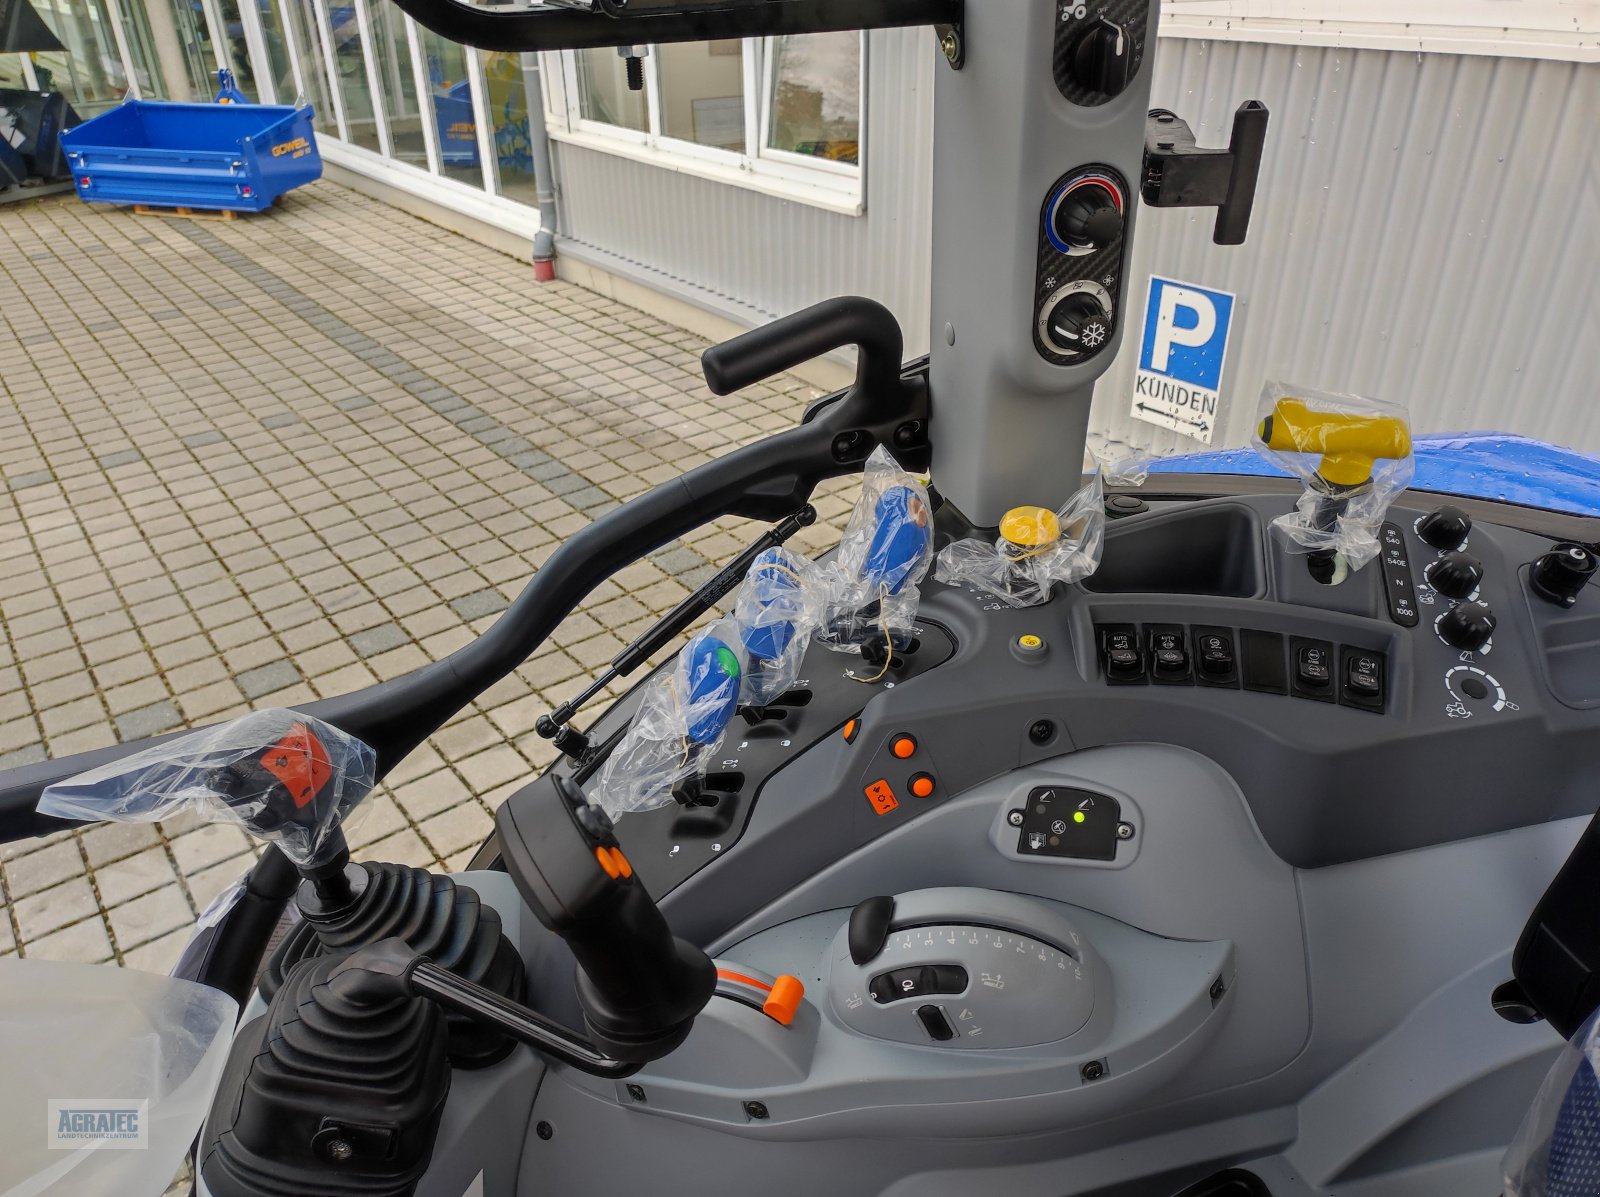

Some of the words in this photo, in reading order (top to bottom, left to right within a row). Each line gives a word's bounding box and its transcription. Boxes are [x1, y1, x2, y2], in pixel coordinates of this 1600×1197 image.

[1150, 283, 1218, 372] P
[1135, 375, 1217, 416] KUNDEN
[1385, 537, 1400, 545] 540
[1387, 557, 1407, 567] 540E
[1396, 607, 1413, 616] 1000
[993, 941, 1003, 949] 6
[1016, 946, 1026, 954] 7
[901, 979, 915, 992] 10
